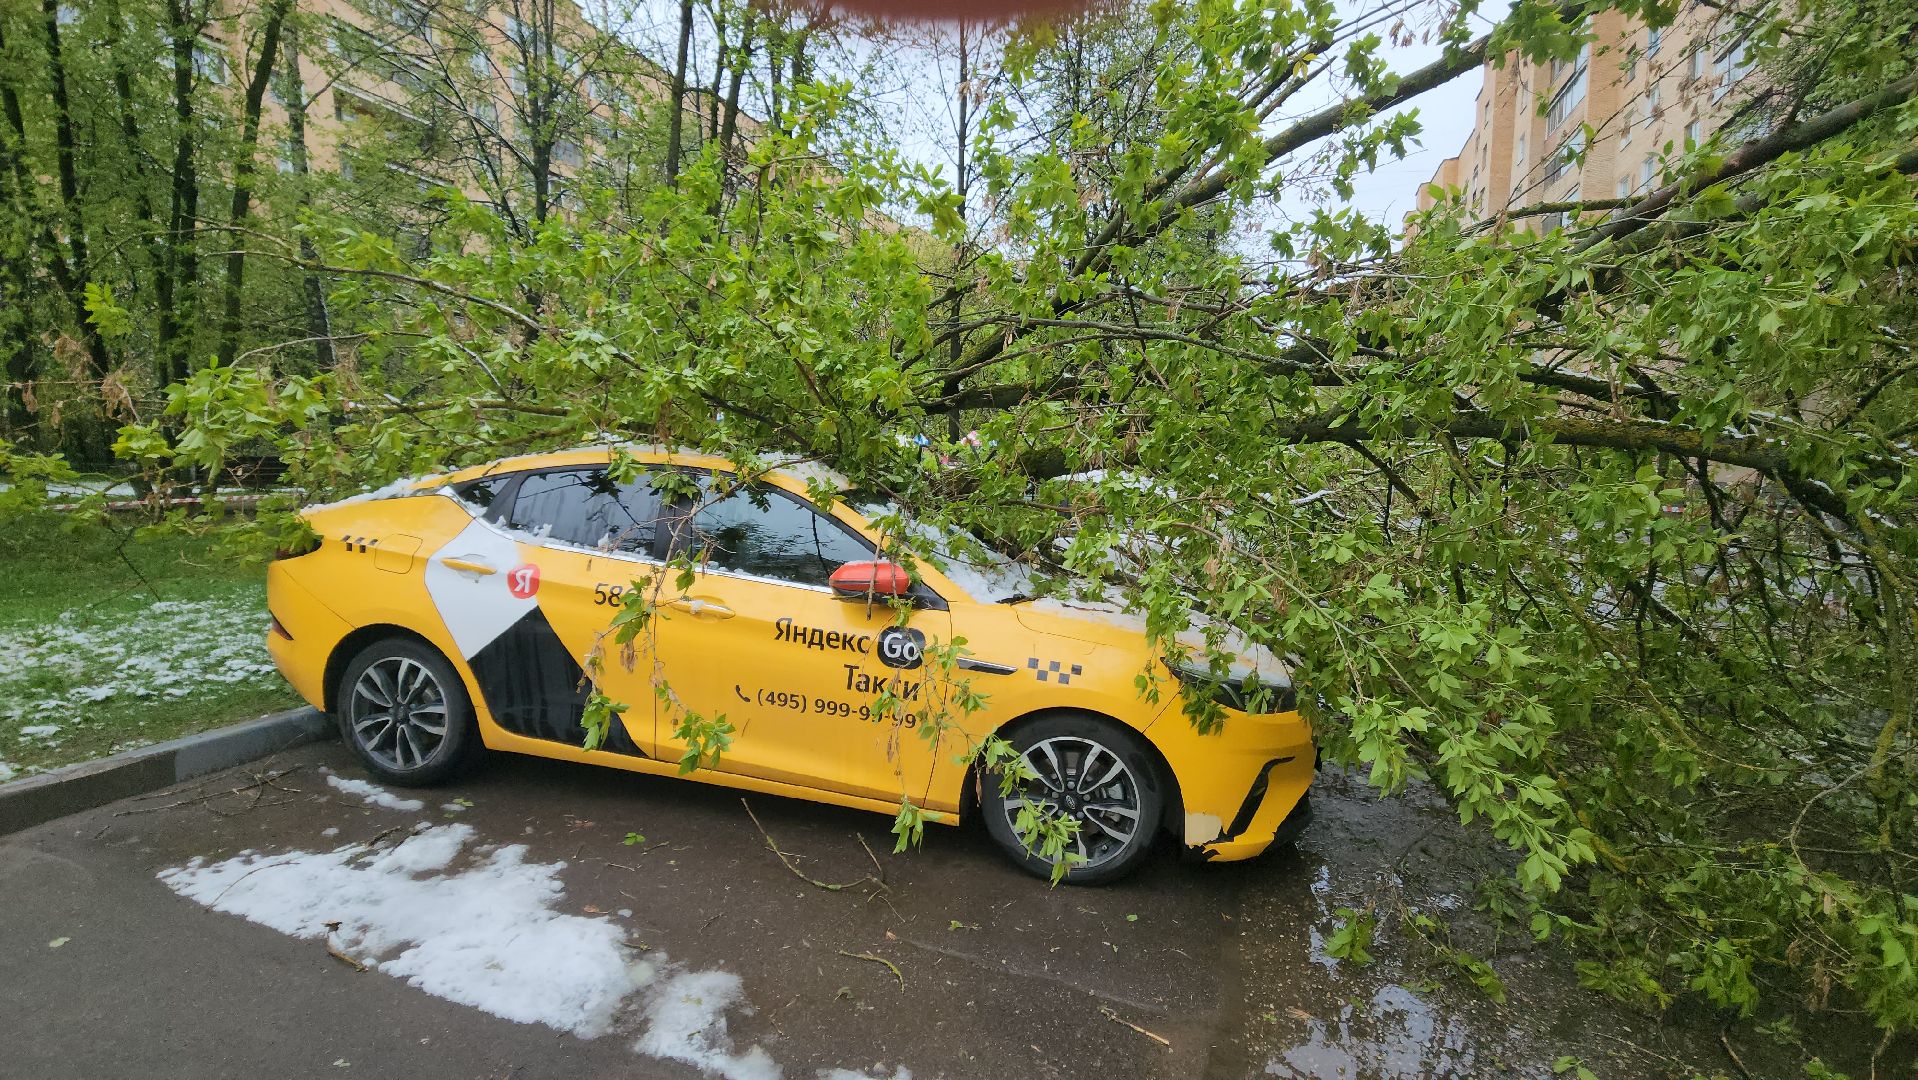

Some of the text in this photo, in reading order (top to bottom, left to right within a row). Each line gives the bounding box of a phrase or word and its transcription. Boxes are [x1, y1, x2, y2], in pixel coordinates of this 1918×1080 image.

[515, 569, 533, 594] Я
[775, 617, 920, 661] Яндекс Go
[757, 689, 806, 713] (495)
